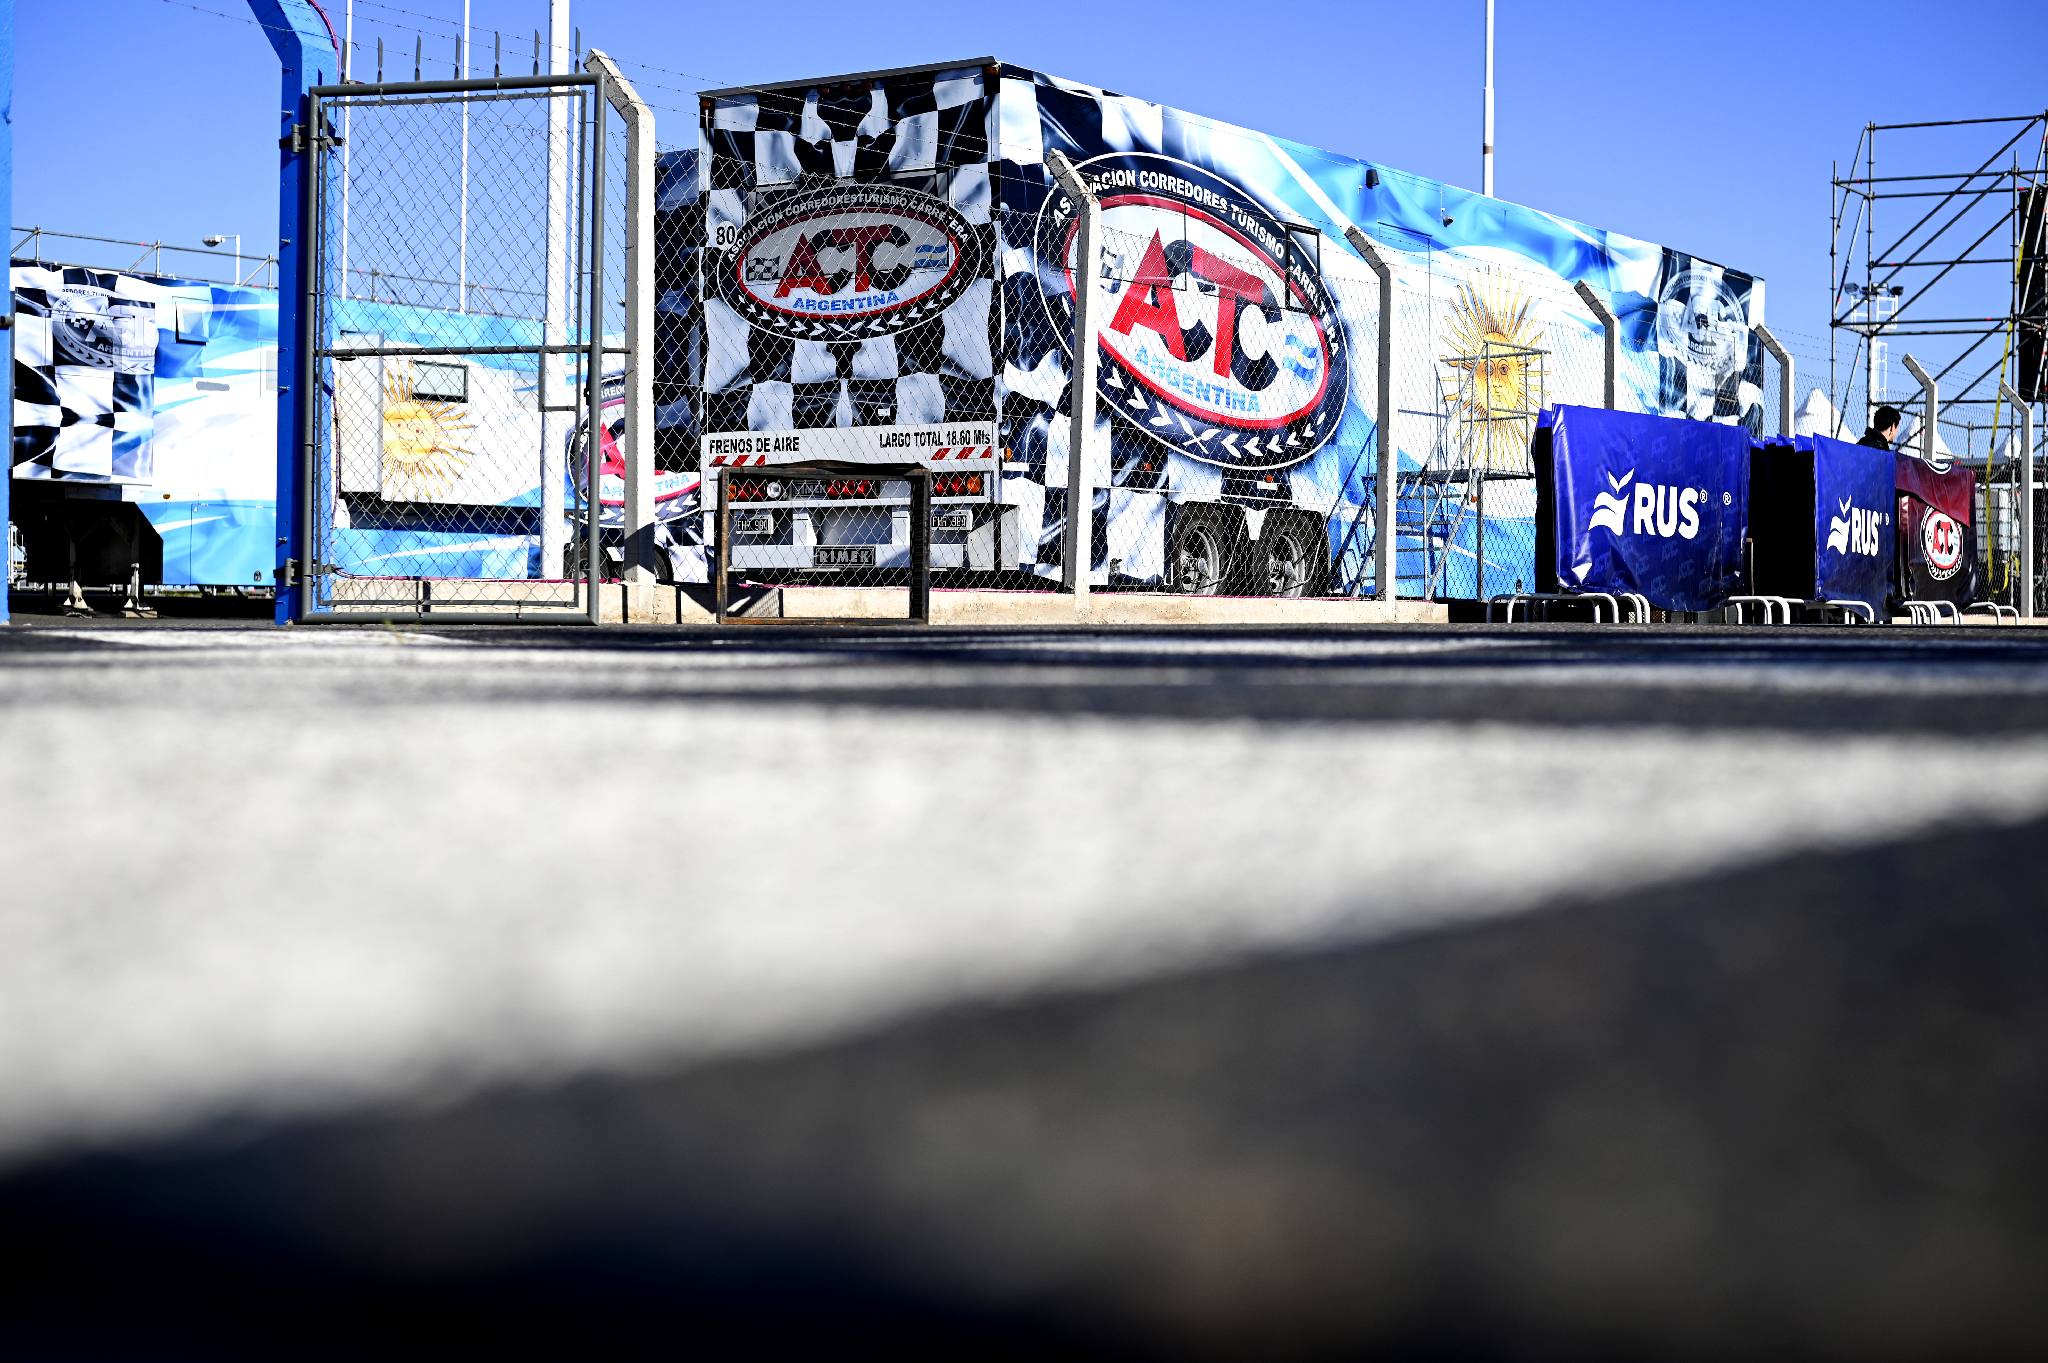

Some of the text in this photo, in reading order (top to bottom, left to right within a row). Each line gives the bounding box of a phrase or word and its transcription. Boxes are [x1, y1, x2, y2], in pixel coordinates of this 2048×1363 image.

[857, 193, 908, 206] TURISMO
[1140, 170, 1228, 213] CORREDORES
[1230, 203, 1285, 259] TURISMO
[716, 225, 736, 246] 80
[793, 290, 900, 311] ARGENTINA
[1135, 344, 1261, 413] ARGENTINA
[709, 436, 800, 454] FRENOS DE AIRE
[879, 433, 911, 448] LARGO
[914, 431, 944, 447] TOTAL
[947, 429, 971, 446] 18.60
[819, 550, 870, 563] RIMEK
